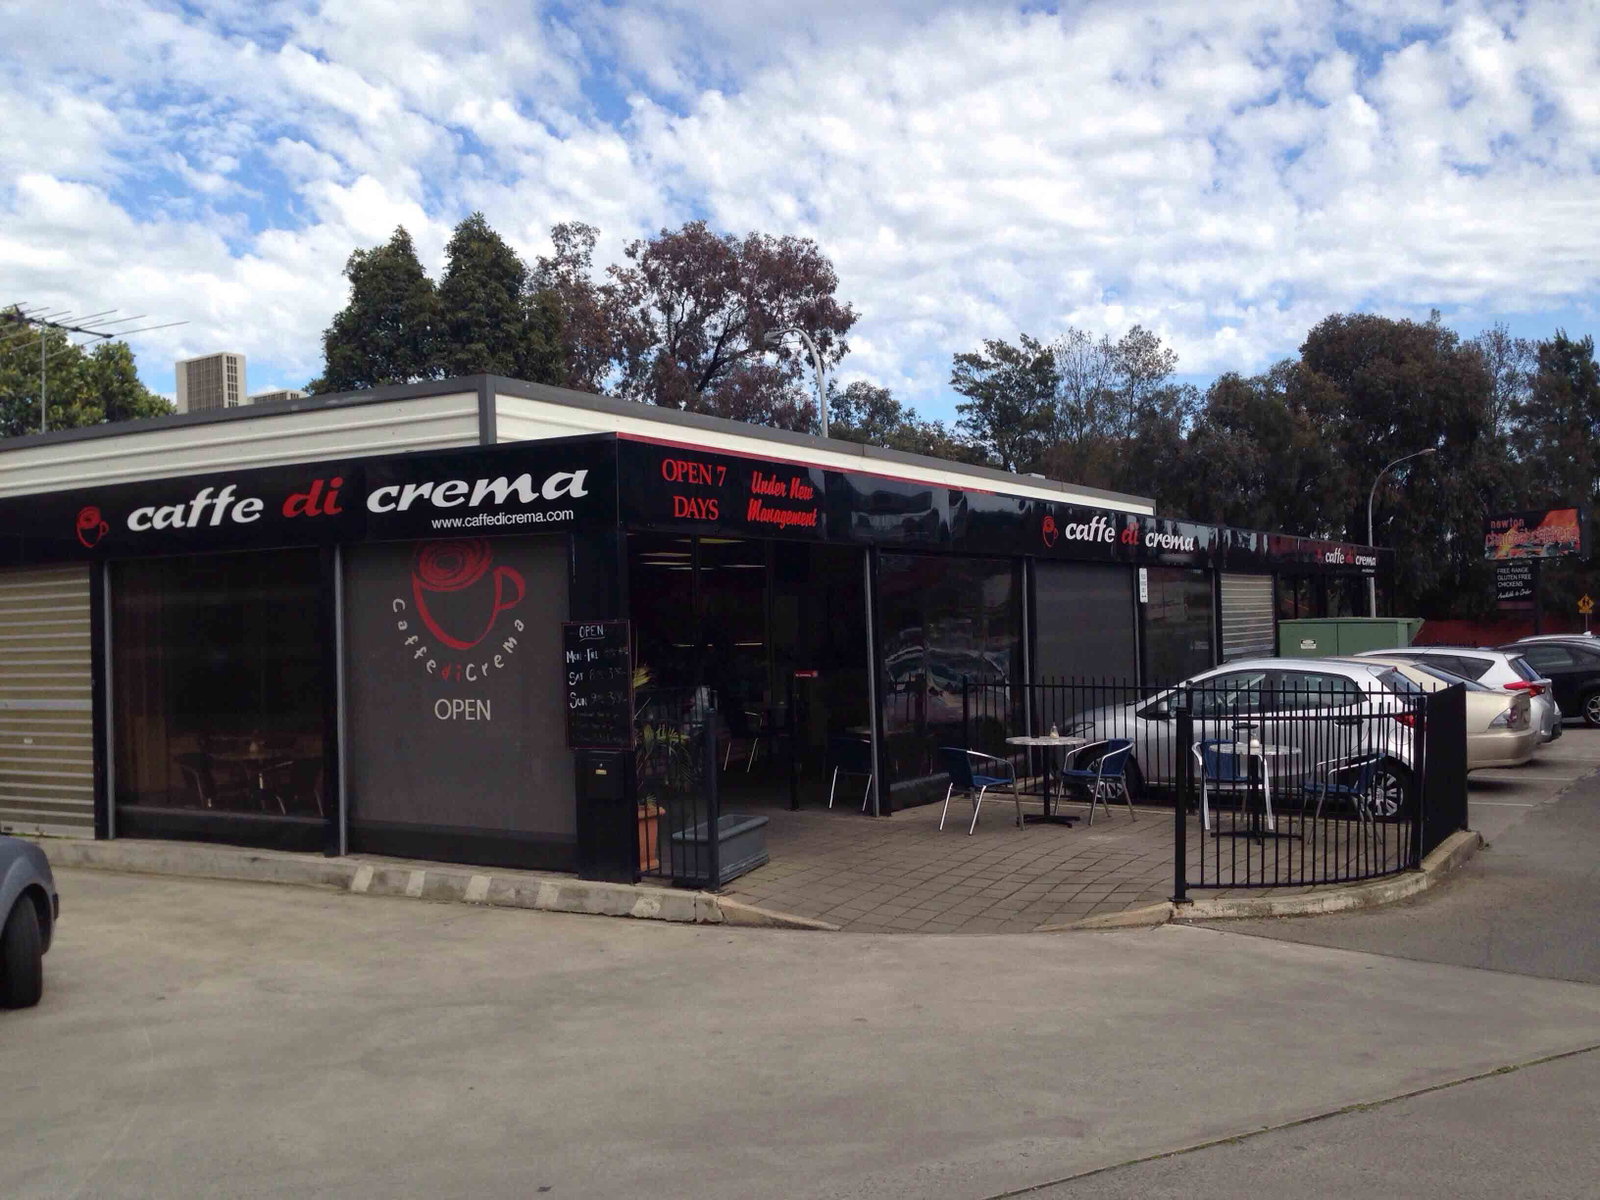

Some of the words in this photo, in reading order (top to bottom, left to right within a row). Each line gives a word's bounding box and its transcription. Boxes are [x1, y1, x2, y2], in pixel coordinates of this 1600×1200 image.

[661, 459, 713, 485] OPEN
[716, 466, 727, 487] 7
[751, 470, 787, 497] Under
[789, 477, 814, 500] New
[127, 484, 264, 532] caffe
[282, 476, 344, 518] di
[366, 469, 589, 513] crema
[672, 495, 720, 521] DAYS
[746, 498, 818, 529] Management
[431, 508, 574, 529] www.caffedicrema.com
[1065, 515, 1116, 543] caffe
[1121, 522, 1140, 545] di
[1145, 531, 1195, 551] crema
[1325, 547, 1345, 564] caffe
[1355, 555, 1377, 566] crema
[1497, 580, 1524, 588] CHICKENS
[579, 625, 605, 638] OPEN
[434, 699, 491, 720] OPEN
